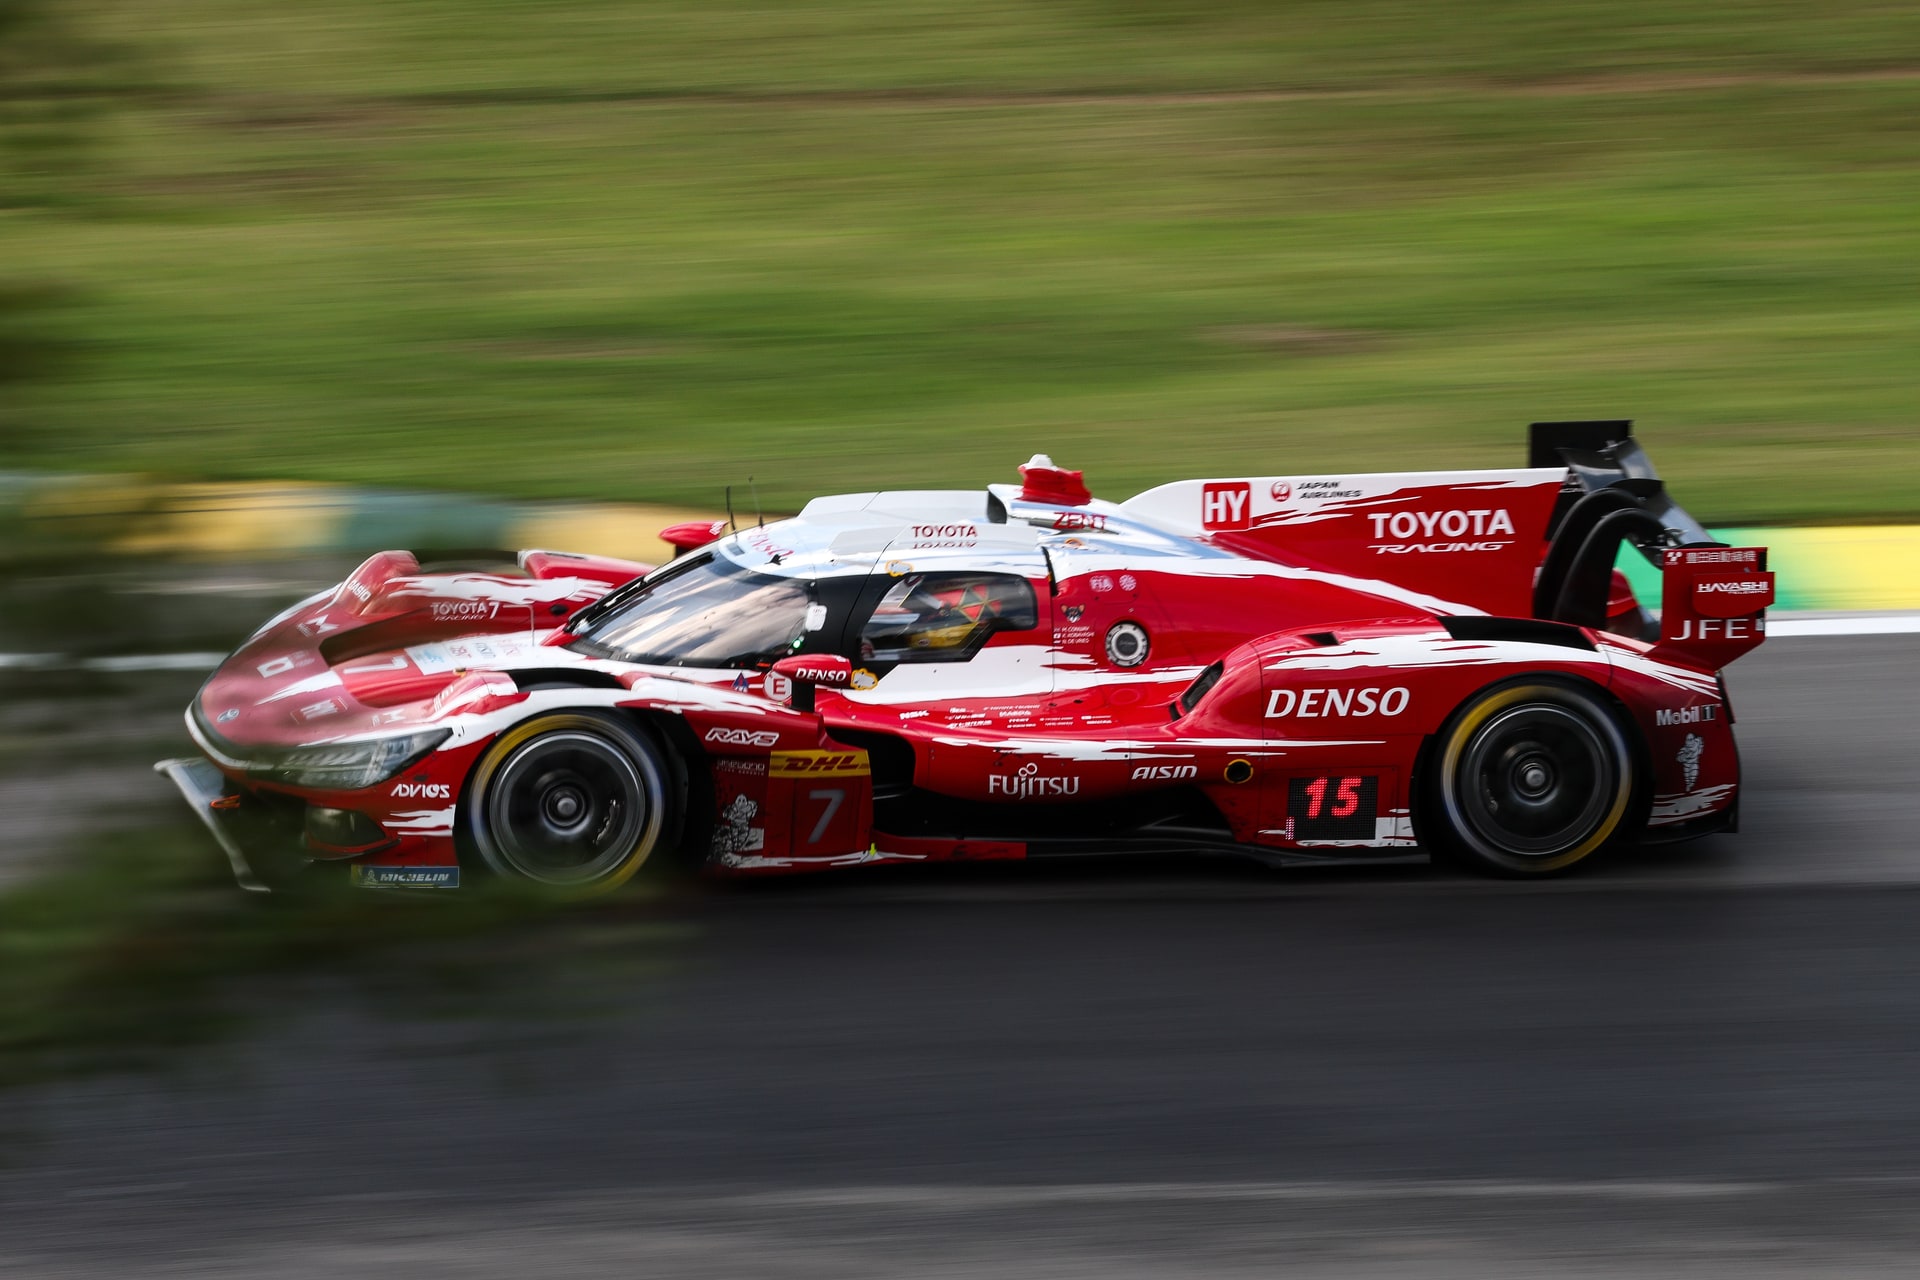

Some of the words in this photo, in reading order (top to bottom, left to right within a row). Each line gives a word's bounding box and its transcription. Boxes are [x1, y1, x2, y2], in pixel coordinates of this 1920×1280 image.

[1298, 482, 1331, 490] JAPAN
[1300, 490, 1362, 499] AIRLINES
[1203, 490, 1248, 523] HY
[912, 525, 978, 538] TOYOTA
[1367, 509, 1515, 538] TOYOTA
[1367, 541, 1515, 554] RACING
[1697, 582, 1769, 593] HAYASHI
[430, 602, 487, 616] TOYOTA
[489, 602, 500, 619] 7
[1670, 619, 1749, 640] JFE
[796, 667, 847, 682] DENSO
[773, 678, 786, 695] E
[1265, 687, 1410, 718] DENSO
[1656, 706, 1700, 726] Mobil
[705, 728, 780, 746] RAYS
[783, 755, 859, 771] DHL
[1131, 766, 1198, 780] AISIN
[989, 772, 1080, 800] FUJITSU
[1305, 777, 1361, 818] 15
[807, 789, 846, 844] 7
[380, 873, 450, 882] MICHELIN
